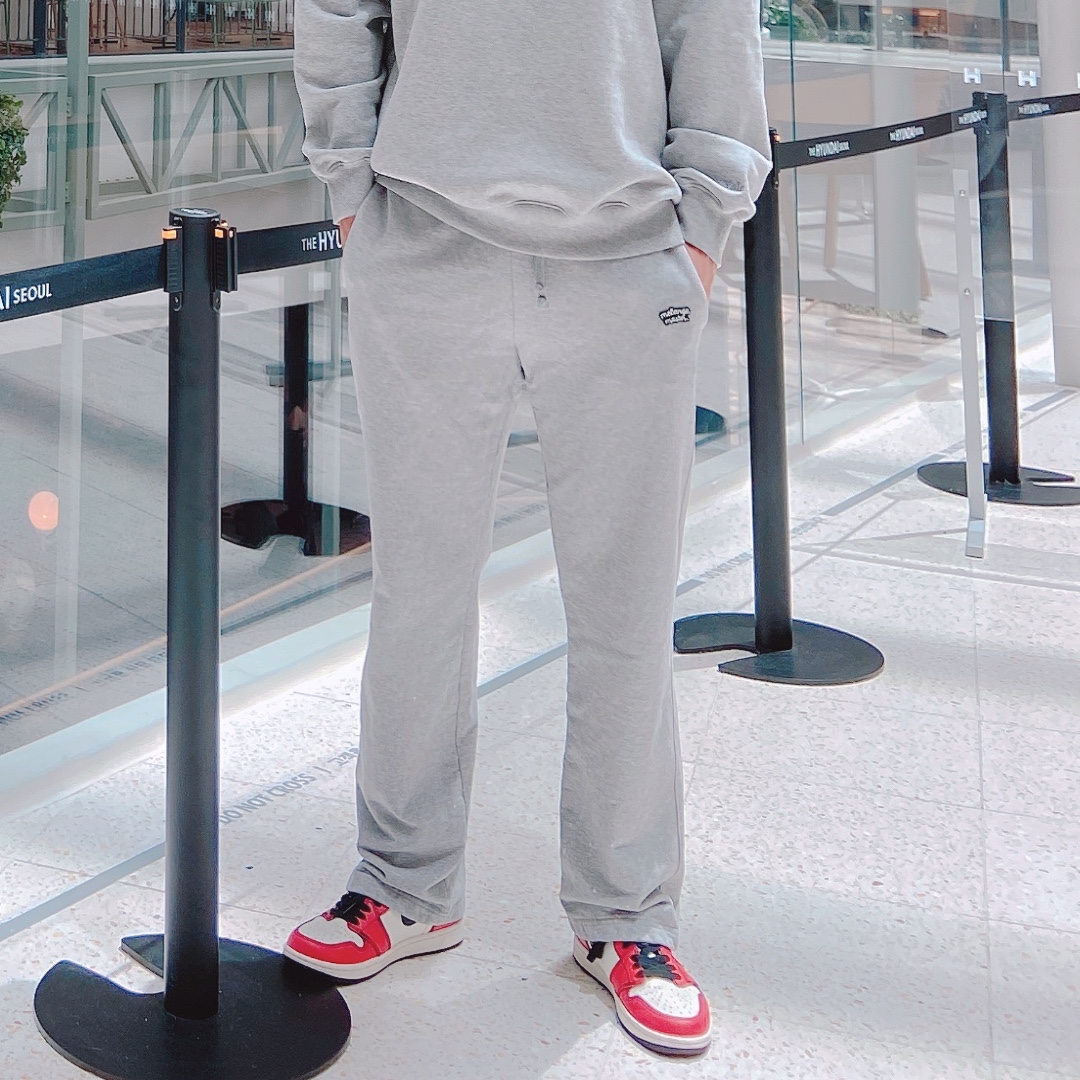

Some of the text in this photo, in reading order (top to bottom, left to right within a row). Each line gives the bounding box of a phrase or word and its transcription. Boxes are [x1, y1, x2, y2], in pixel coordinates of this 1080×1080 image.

[301, 236, 317, 251] THE
[12, 283, 52, 305] SEOUL
[236, 793, 274, 813] NOT
[267, 773, 317, 797] CROSS
